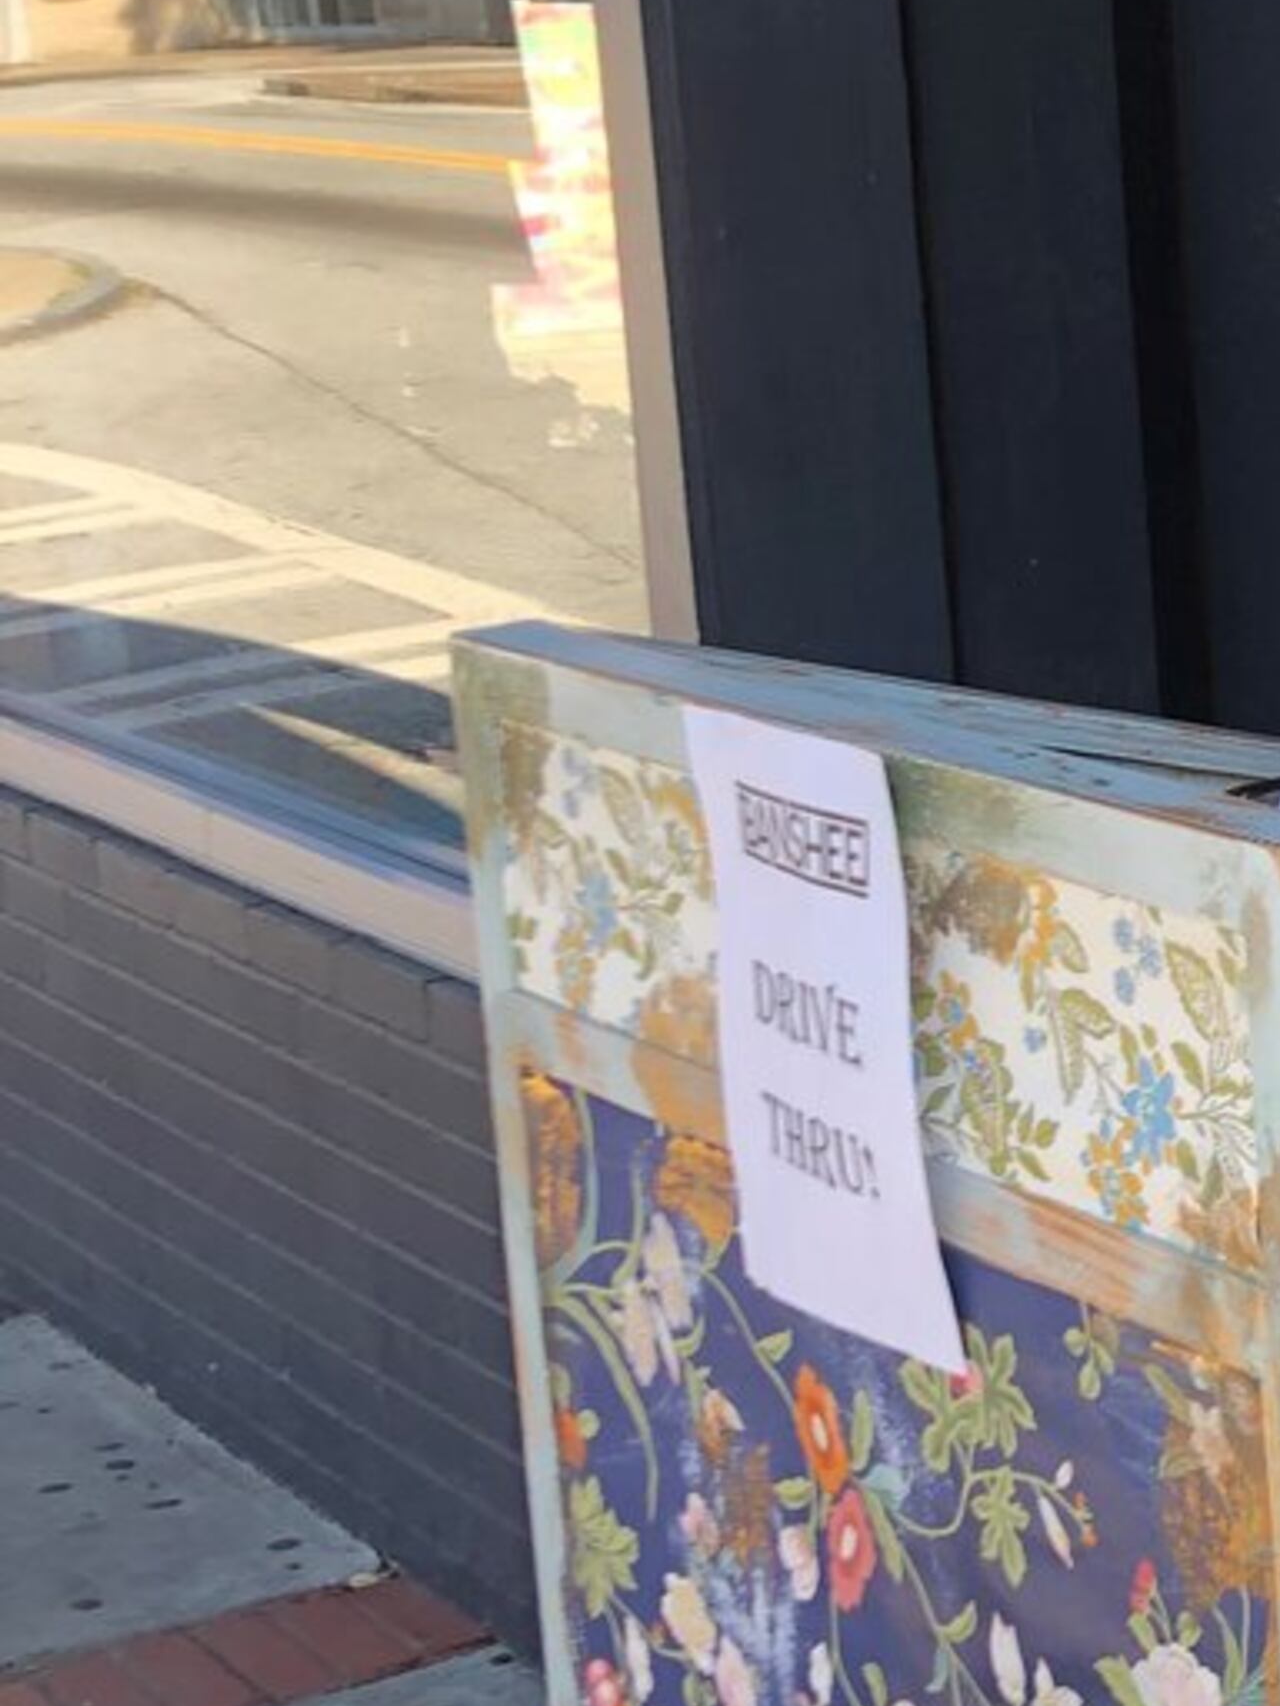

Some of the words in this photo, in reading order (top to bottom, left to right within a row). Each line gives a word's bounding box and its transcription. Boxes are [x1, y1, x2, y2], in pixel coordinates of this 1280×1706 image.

[738, 792, 867, 887] BANSHEE
[754, 960, 861, 1067] DRIVE
[762, 1091, 880, 1200] THRU!
